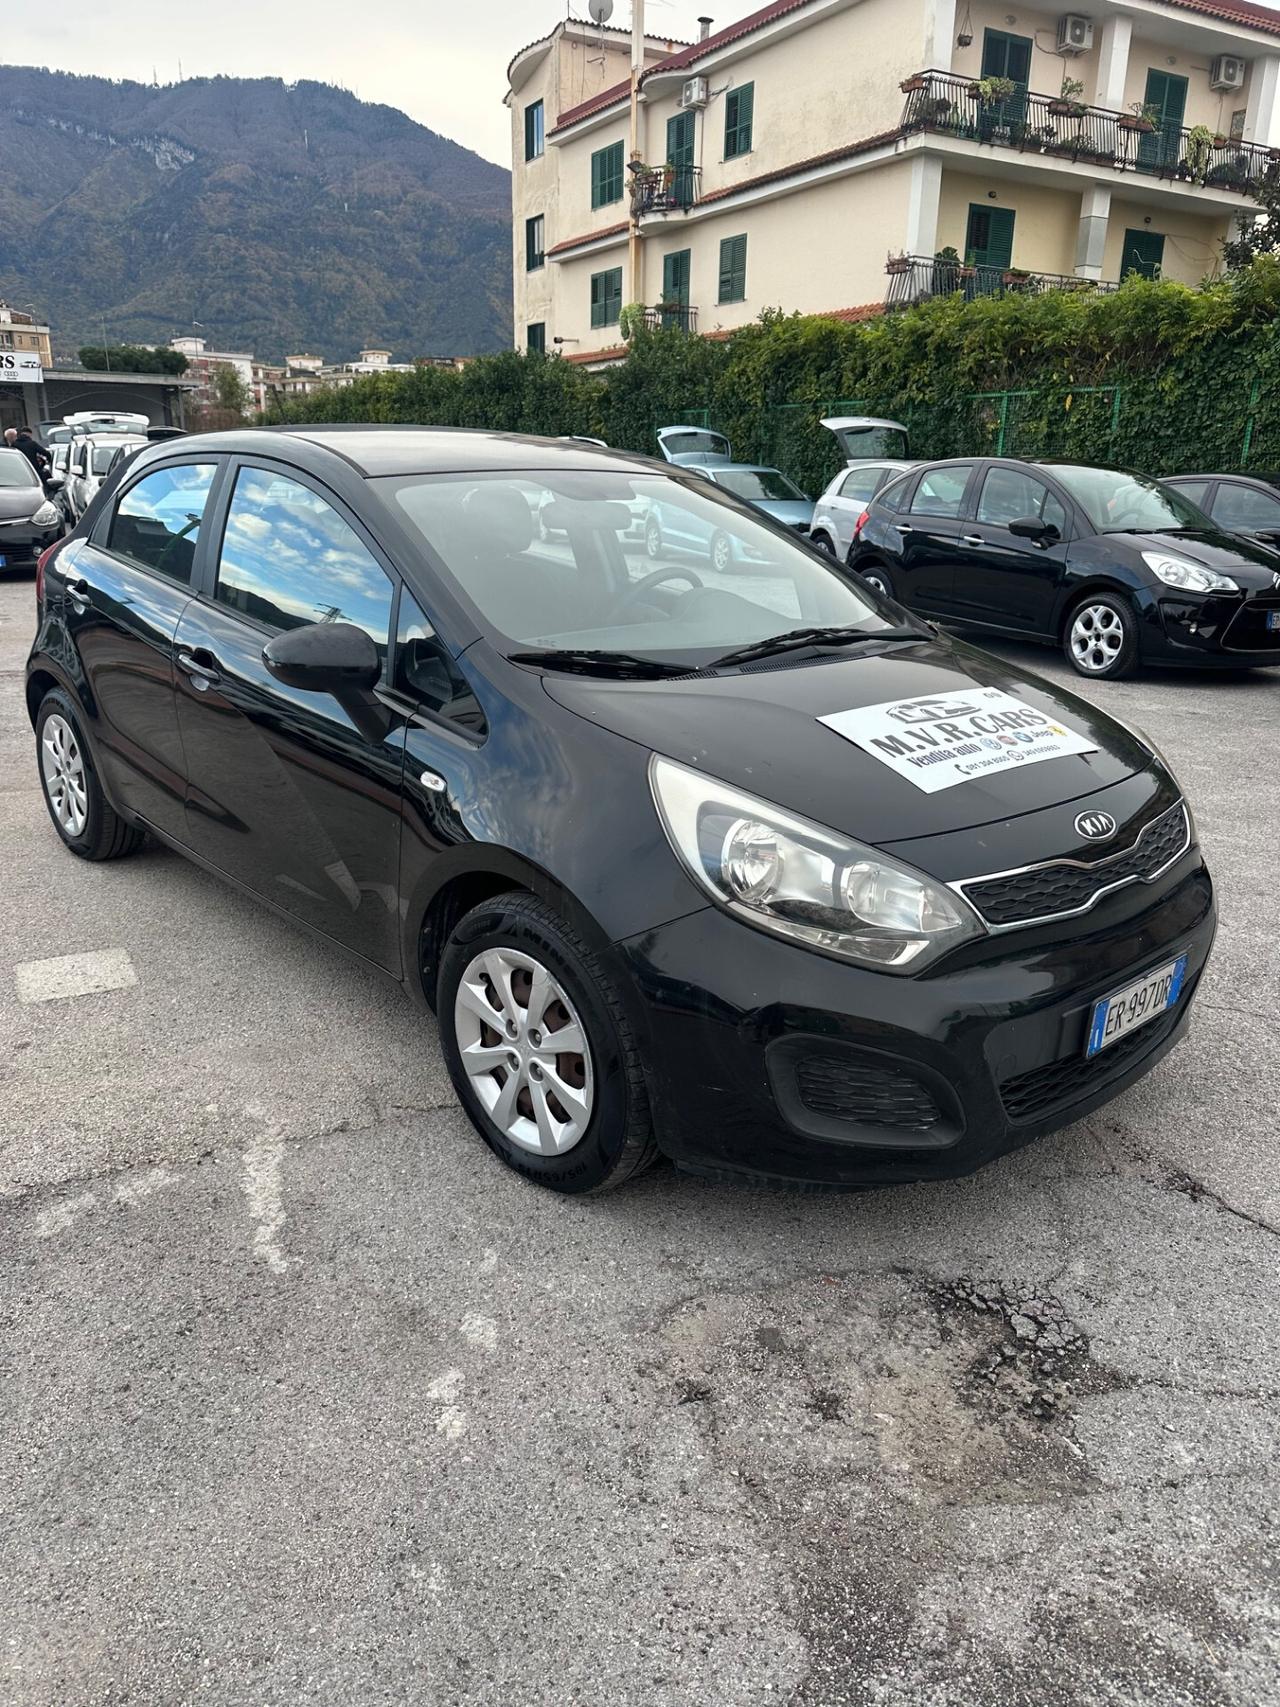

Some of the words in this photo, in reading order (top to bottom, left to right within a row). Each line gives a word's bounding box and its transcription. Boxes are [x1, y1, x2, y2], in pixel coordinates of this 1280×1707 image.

[906, 749, 958, 768] Vendita
[952, 743, 983, 756] auto
[1080, 814, 1112, 836] KIA
